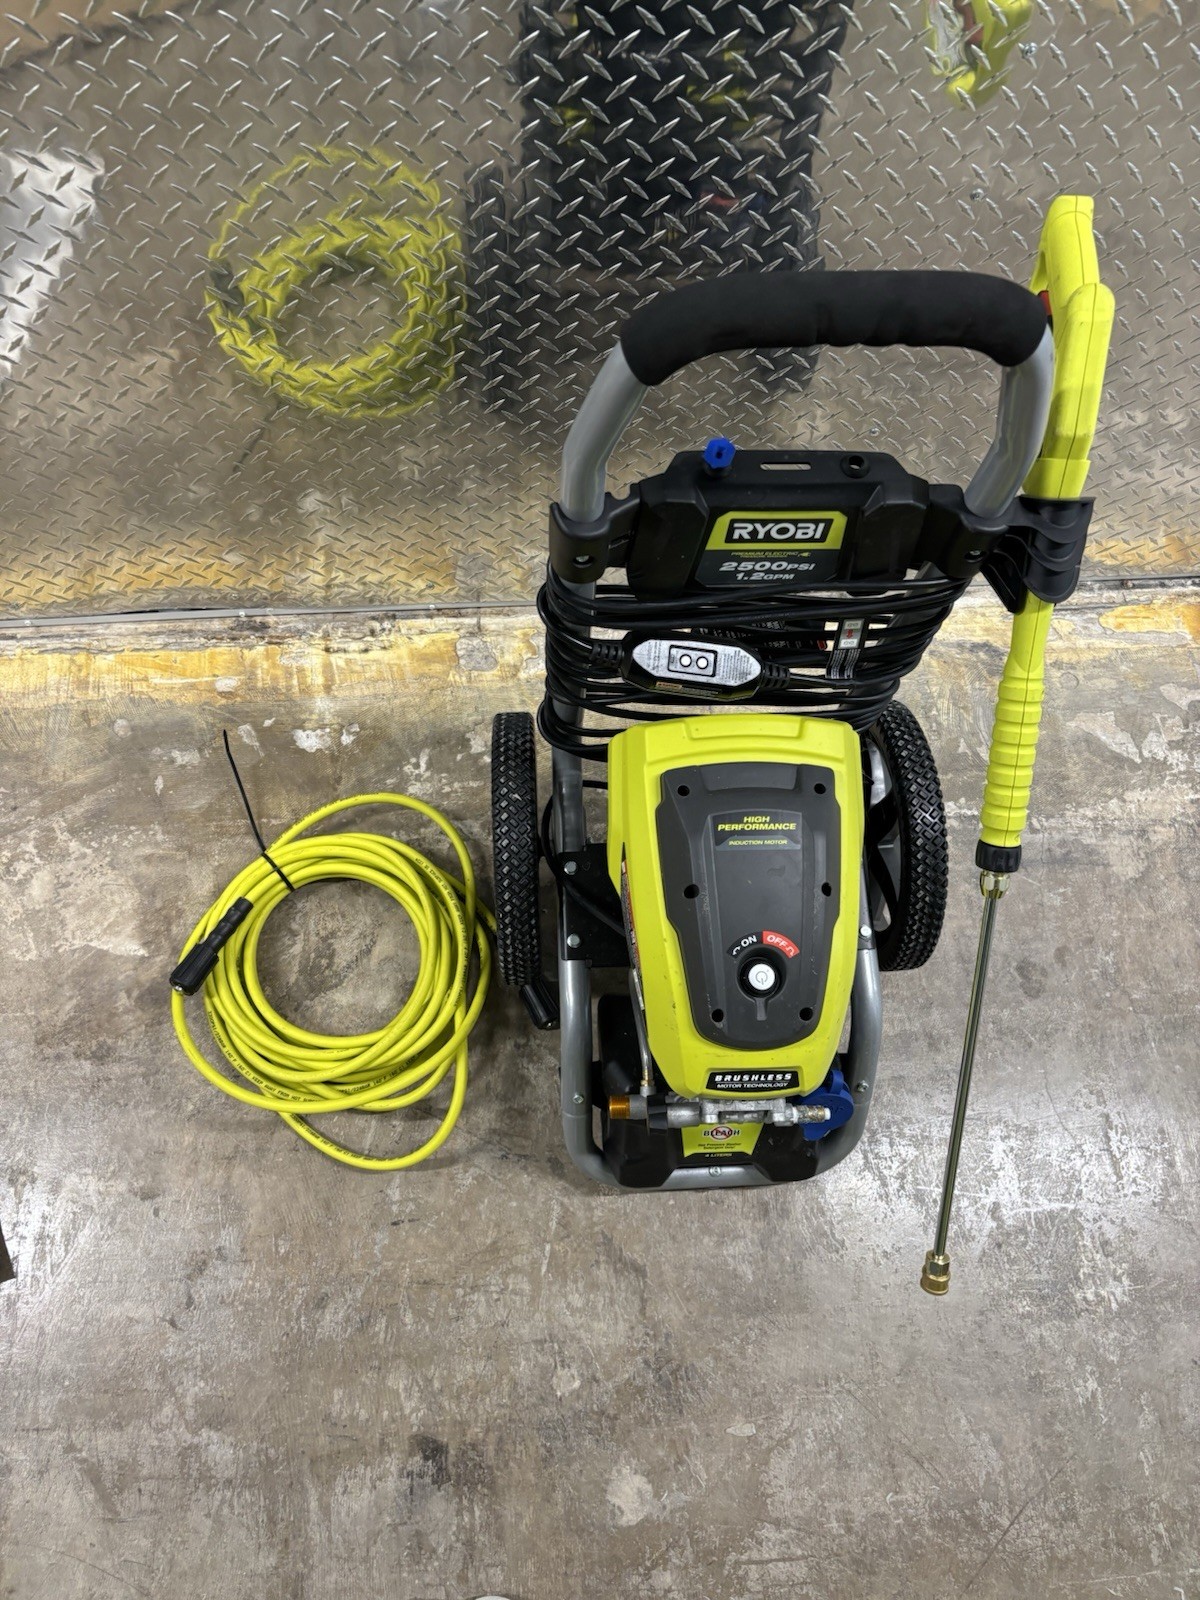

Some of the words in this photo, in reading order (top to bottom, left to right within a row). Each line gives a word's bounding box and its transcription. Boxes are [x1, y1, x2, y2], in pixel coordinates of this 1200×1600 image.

[732, 522, 826, 540] RYOBI
[719, 561, 816, 571] 2500PSI
[736, 572, 795, 580] 1.2GPM
[717, 823, 797, 831] PERFORMANCE
[740, 935, 758, 947] ON
[766, 935, 788, 947] OFF
[715, 1073, 792, 1082] BRUSHLESS
